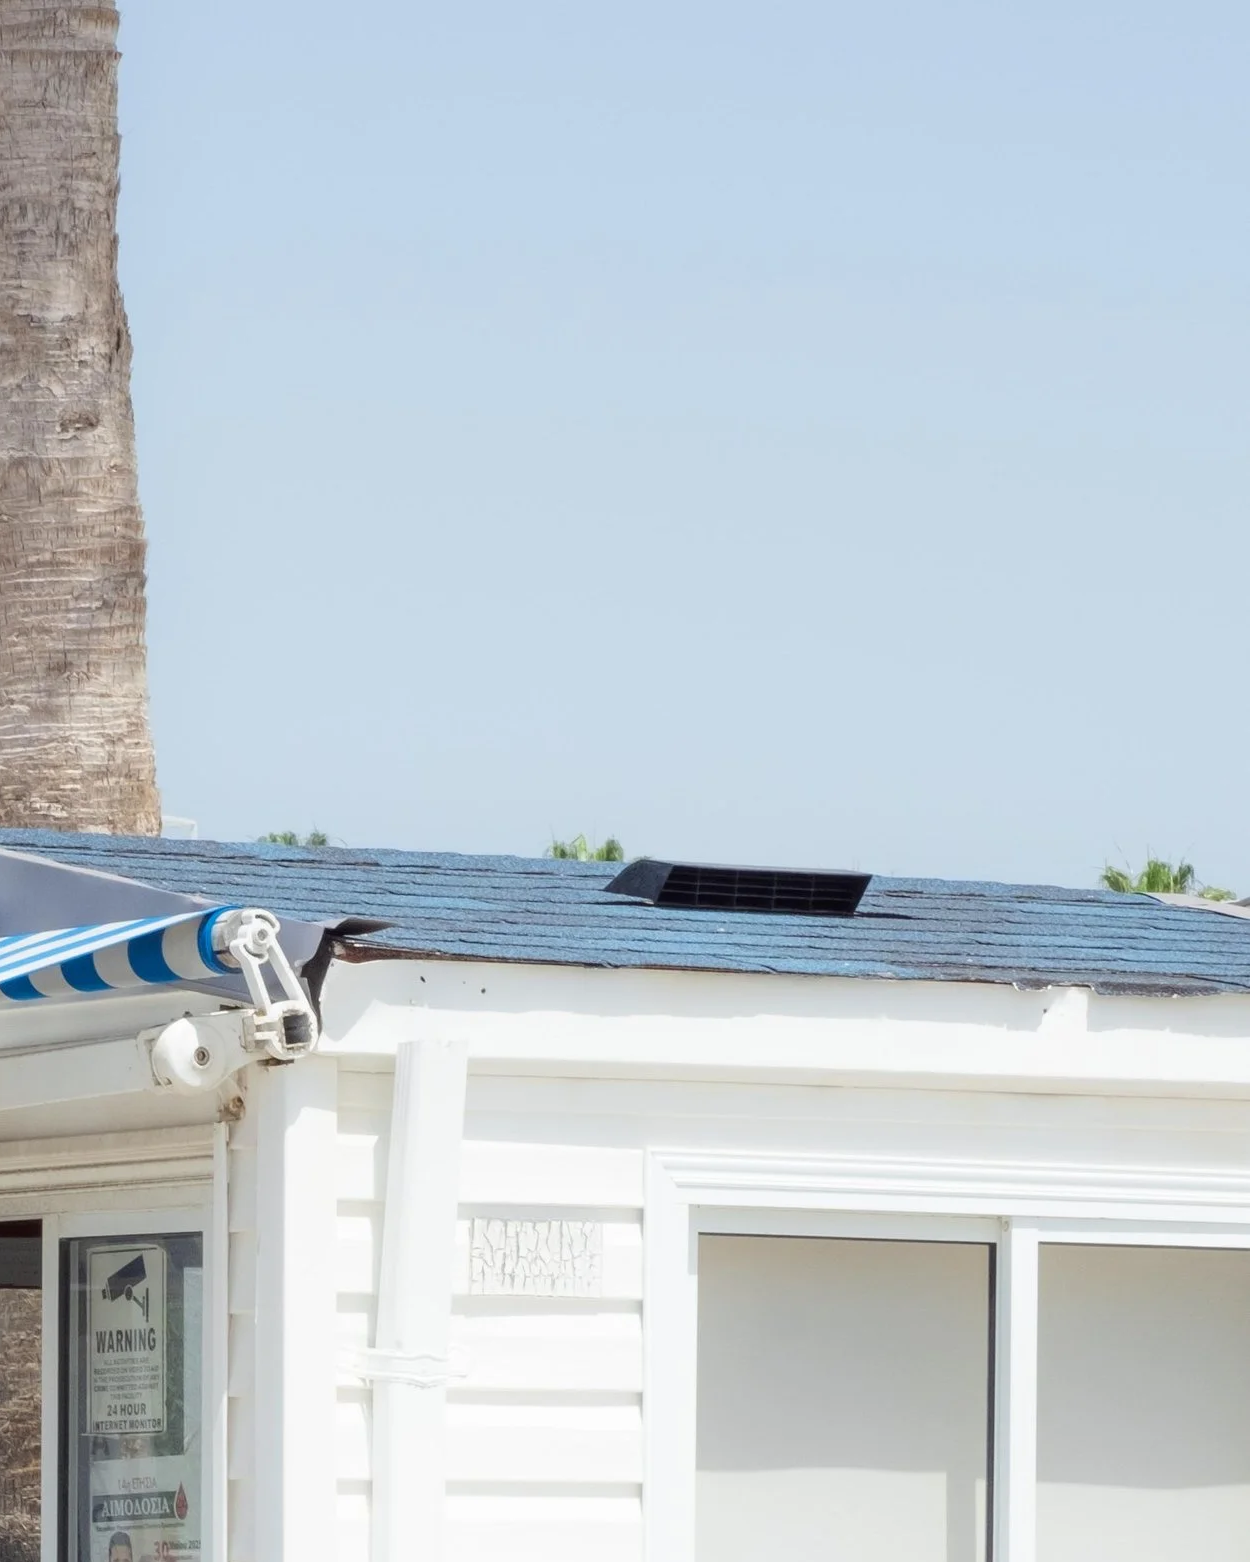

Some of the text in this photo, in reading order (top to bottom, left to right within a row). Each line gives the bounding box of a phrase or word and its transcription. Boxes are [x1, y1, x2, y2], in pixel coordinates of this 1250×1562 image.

[96, 1327, 156, 1353] WARNING
[107, 1402, 147, 1416] 24 HOUR
[93, 1418, 162, 1431] INTERNET MONITOR
[101, 1497, 170, 1518] ΑΙΜΟΔΟΣΙΑ
